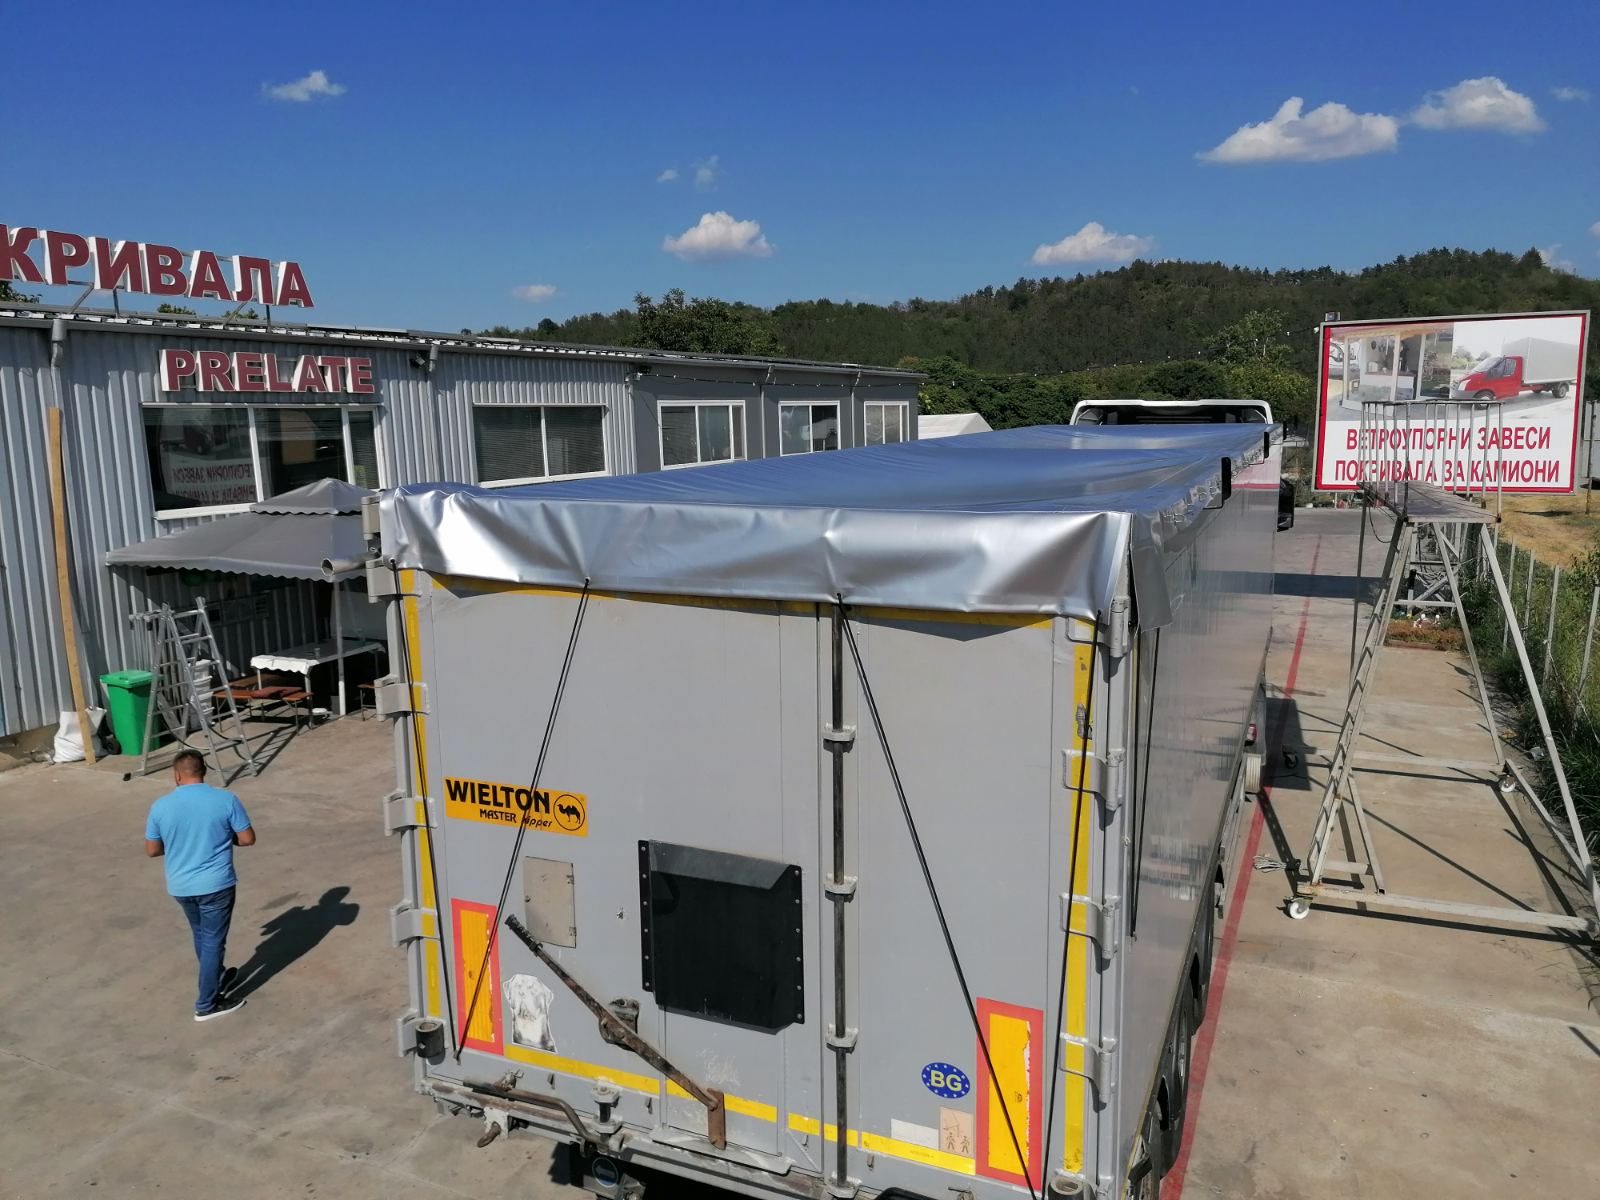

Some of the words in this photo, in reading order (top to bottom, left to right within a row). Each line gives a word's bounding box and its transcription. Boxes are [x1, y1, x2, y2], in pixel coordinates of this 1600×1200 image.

[0, 223, 314, 308] КРИВАЛА
[161, 348, 375, 394] PRELATE
[1477, 426, 1551, 450] ЗАВЕСИ
[1443, 459, 1465, 482] ЗА
[1470, 459, 1560, 483] КАМИОНИ
[445, 778, 551, 814] WIELTON
[479, 808, 517, 824] MASTER
[930, 1069, 962, 1092] BG
